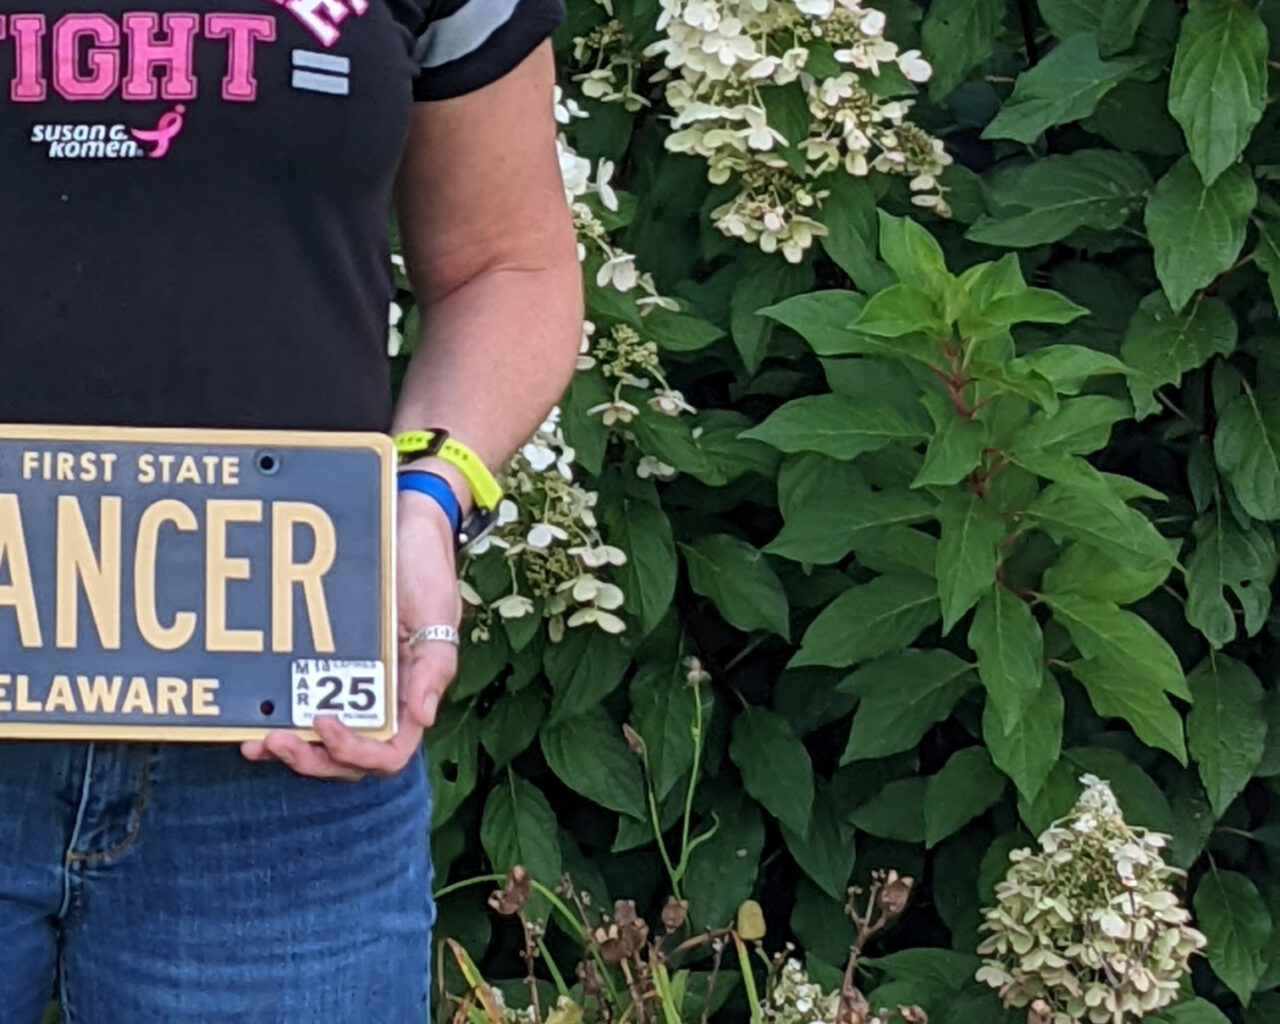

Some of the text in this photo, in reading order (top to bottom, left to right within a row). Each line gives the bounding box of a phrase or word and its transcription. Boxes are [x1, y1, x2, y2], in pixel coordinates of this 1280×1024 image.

[31, 124, 106, 142] susan
[48, 140, 138, 158] komen
[22, 450, 118, 482] FIRST
[137, 453, 240, 485] STATE
[295, 661, 309, 706] MAR
[316, 676, 376, 711] 25
